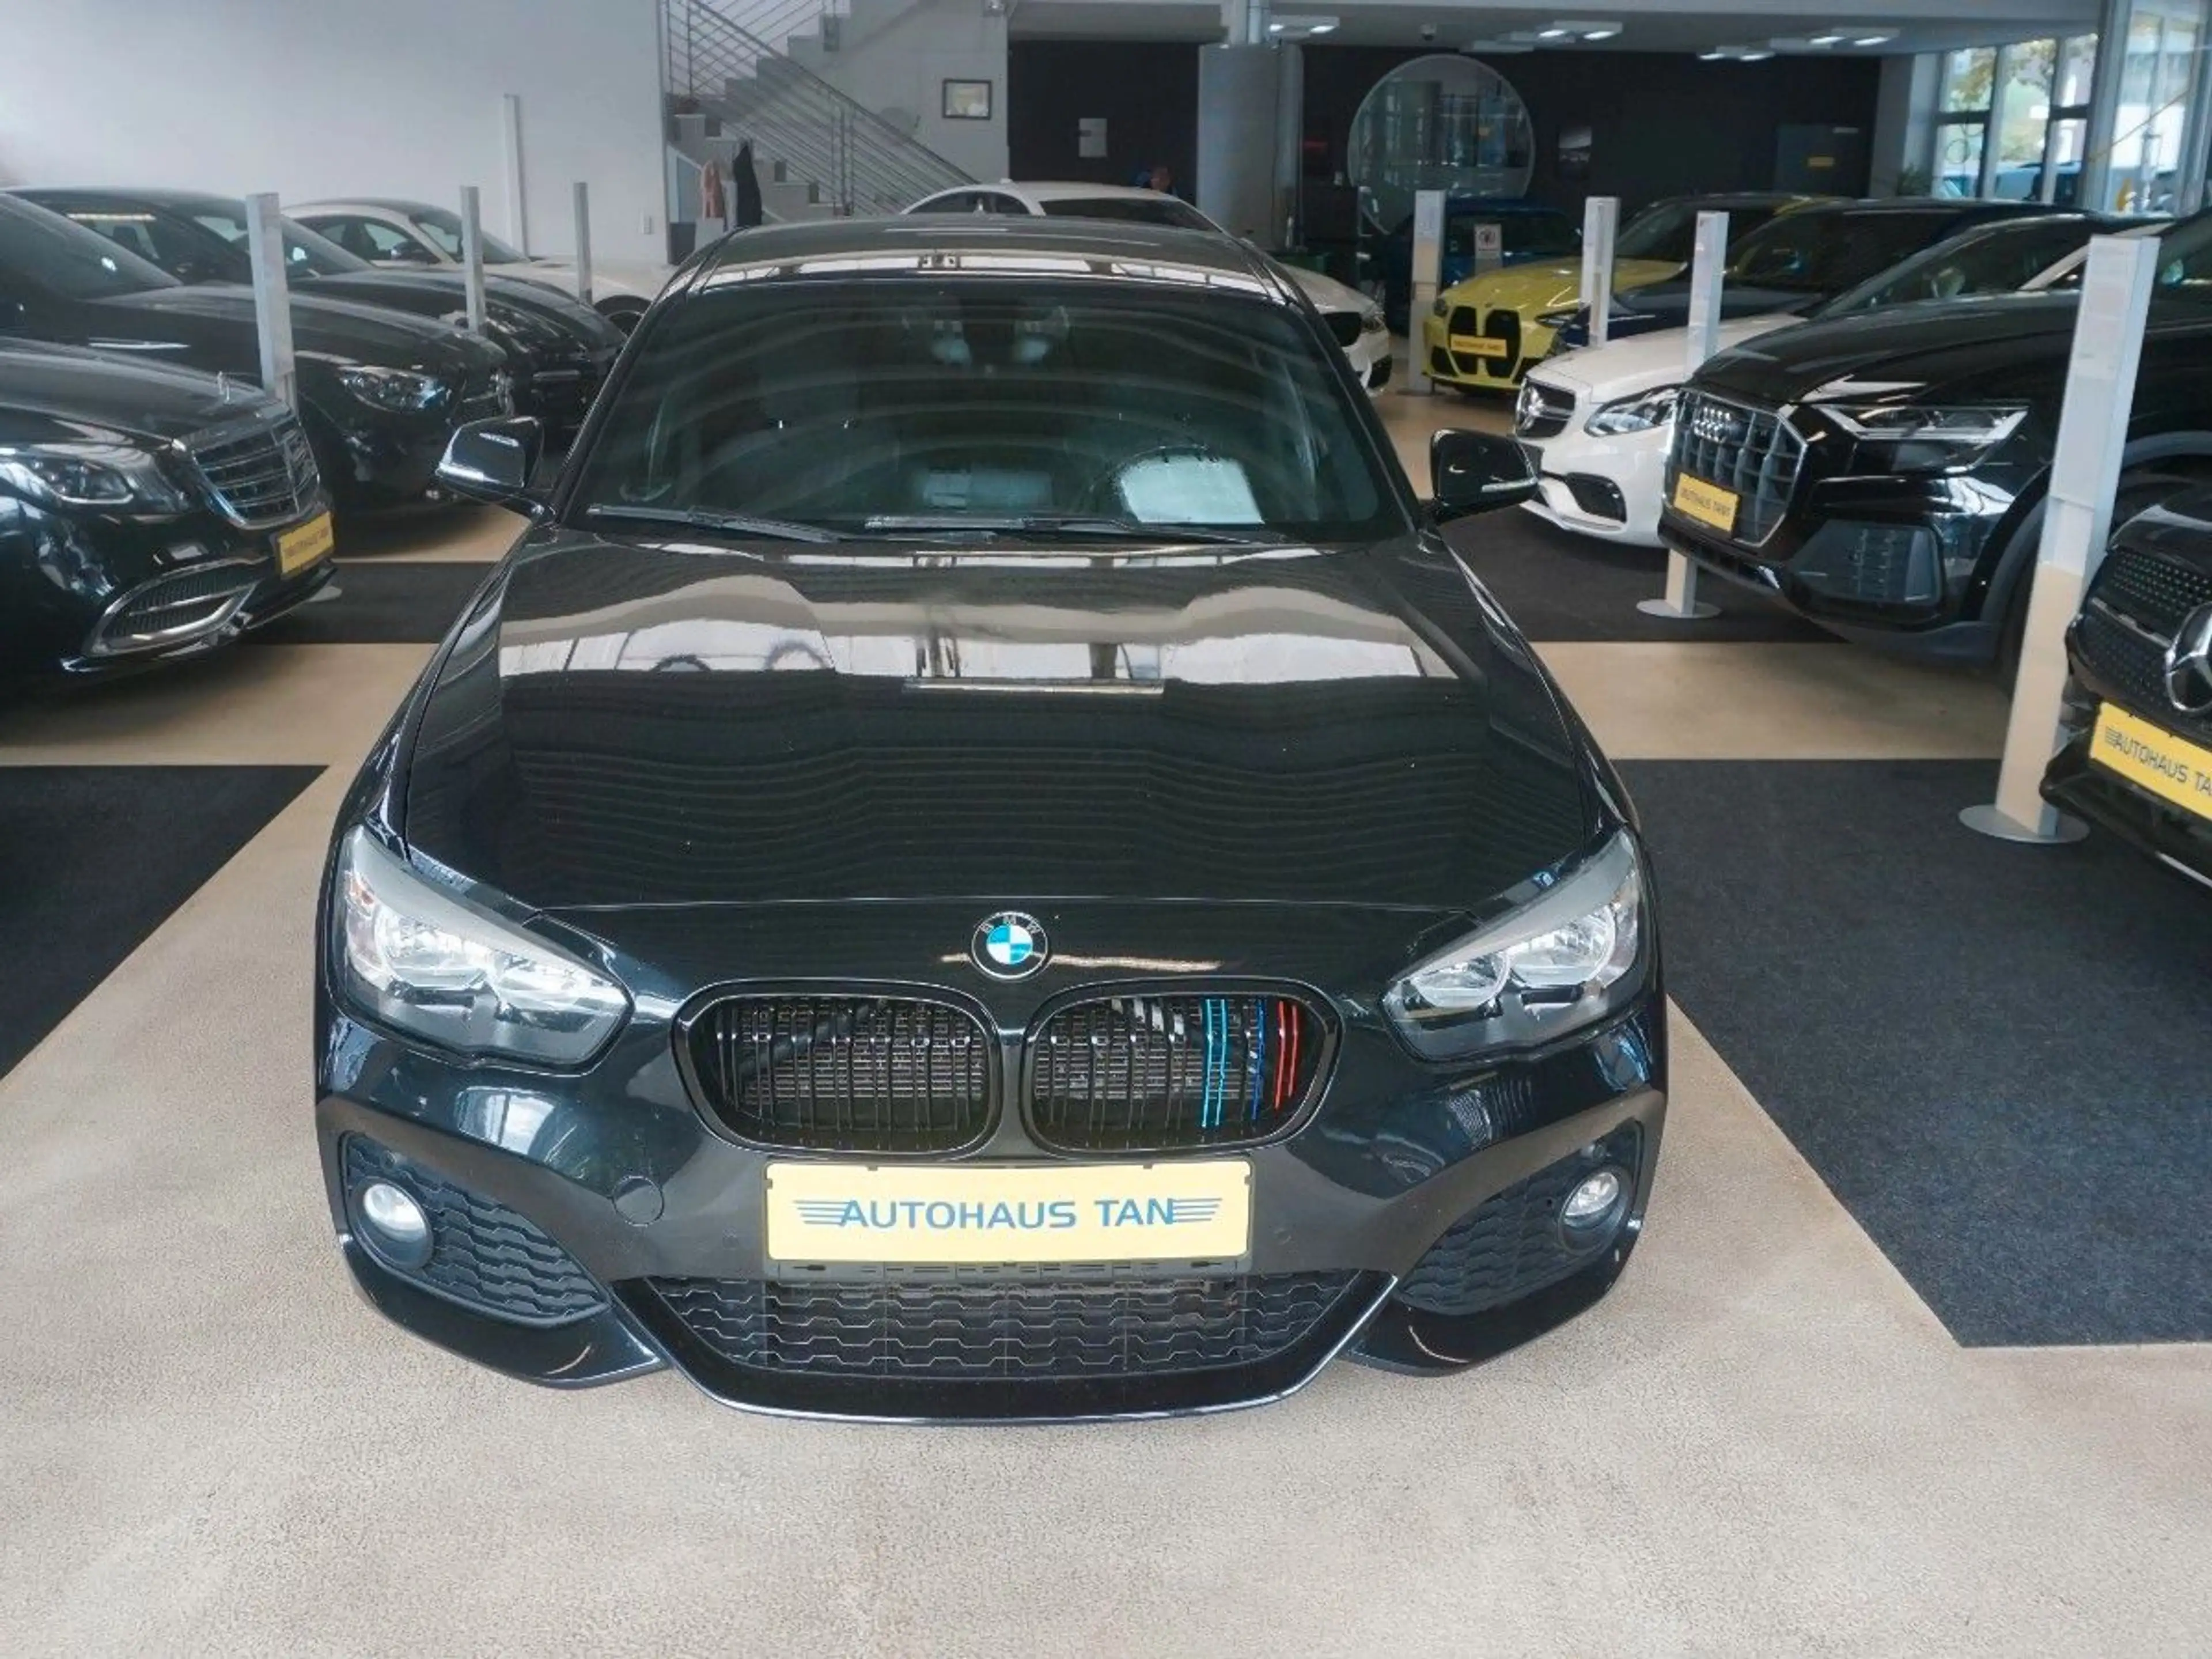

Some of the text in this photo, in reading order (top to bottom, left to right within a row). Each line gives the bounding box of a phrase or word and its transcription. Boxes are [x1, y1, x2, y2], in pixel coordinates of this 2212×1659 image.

[2113, 731, 2188, 783] AUTOHAUS
[840, 1198, 1175, 1229] AUTOHAUS TAN
